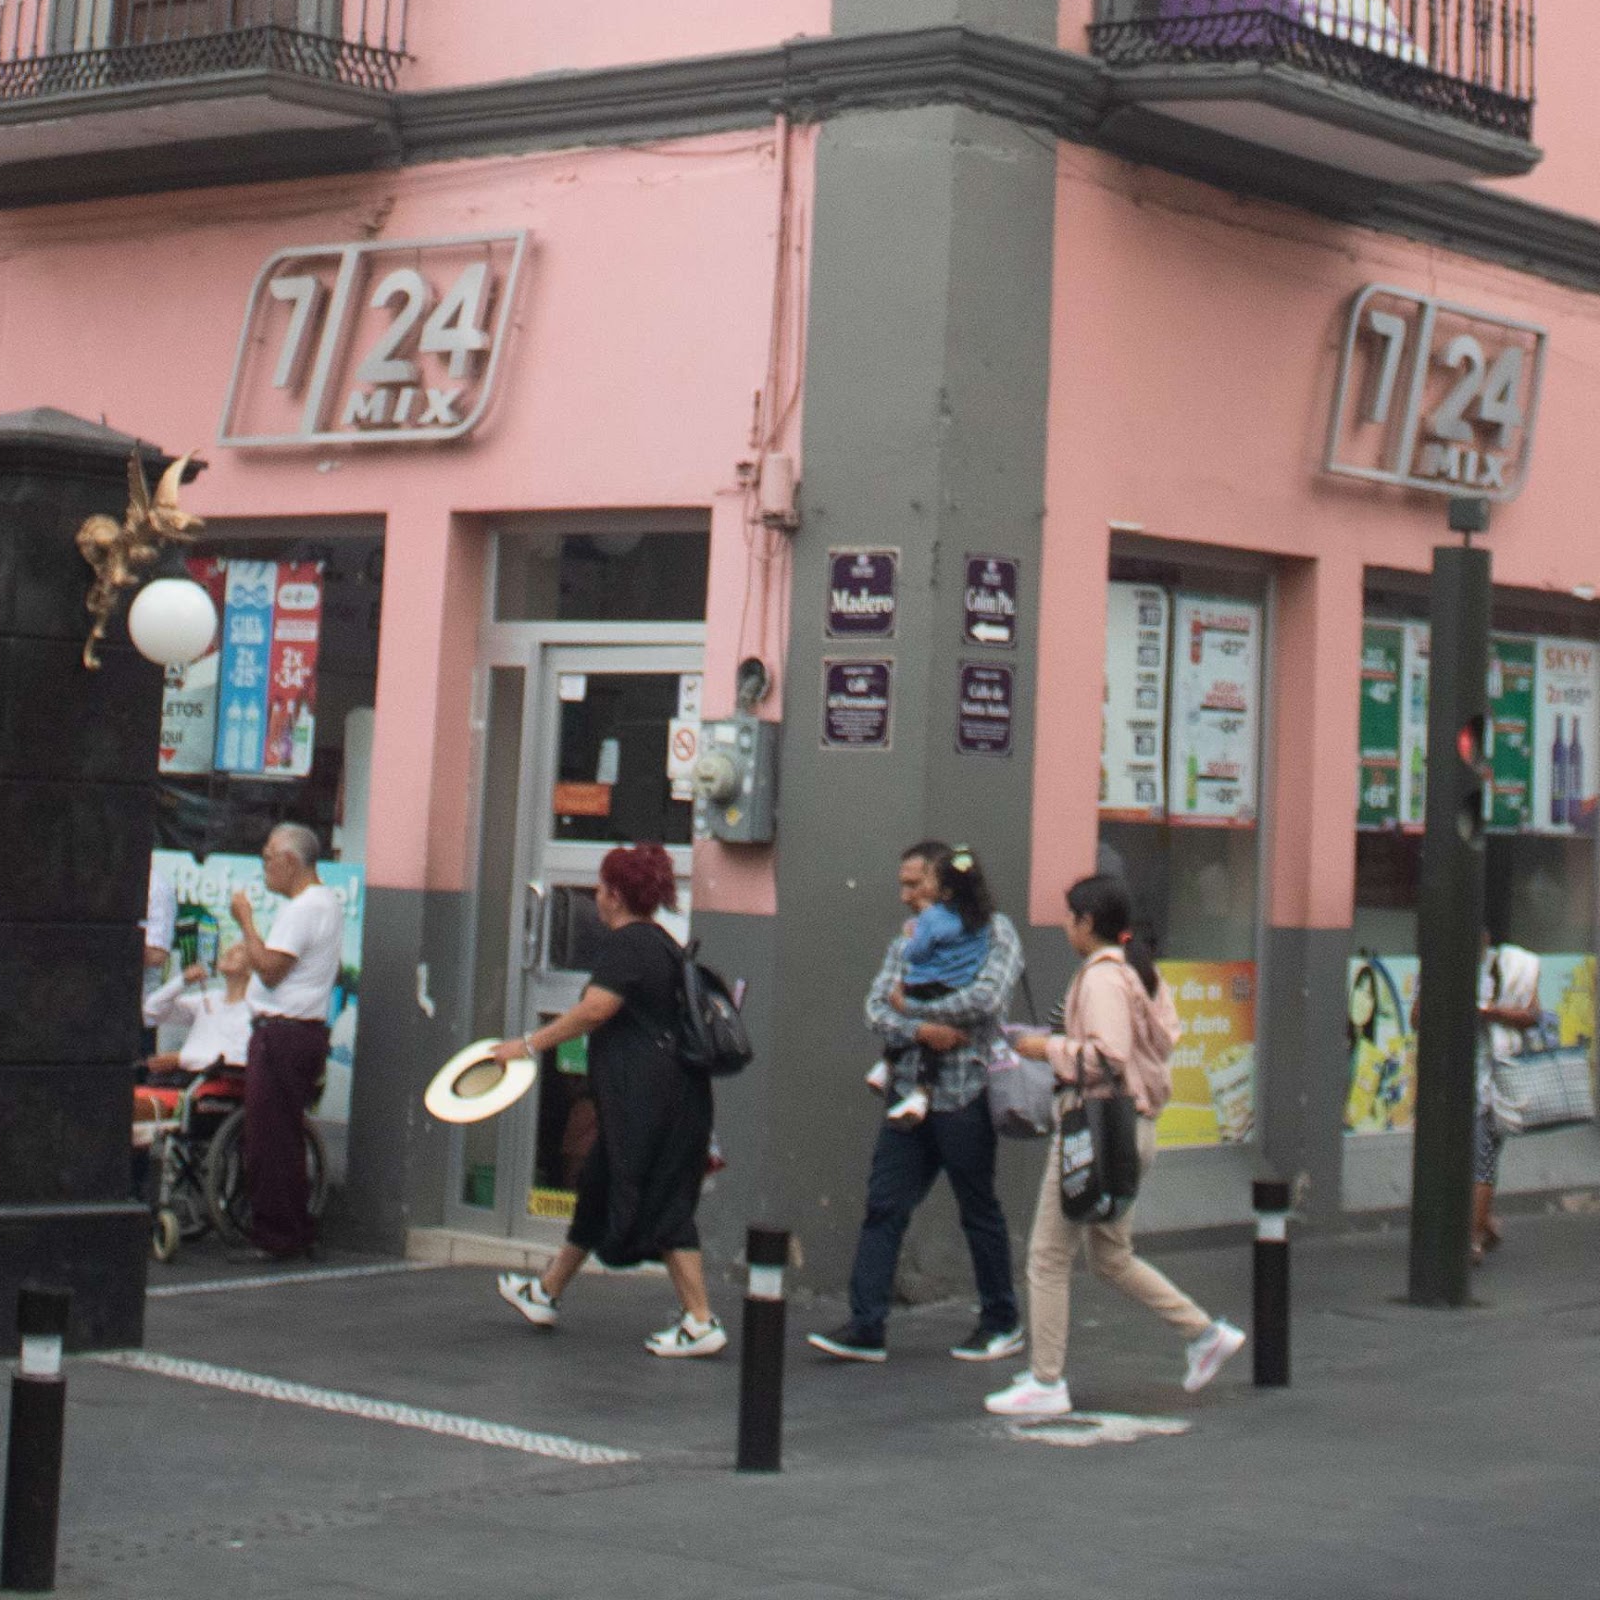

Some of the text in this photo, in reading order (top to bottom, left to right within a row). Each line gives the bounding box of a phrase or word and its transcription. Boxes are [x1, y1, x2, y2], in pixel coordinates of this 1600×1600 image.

[269, 261, 490, 388] 7 24
[1370, 309, 1525, 450] 7 24
[341, 385, 464, 425] MIX
[1420, 442, 1510, 488] MIX
[831, 586, 895, 614] Madero
[1546, 647, 1592, 673] SKYY
